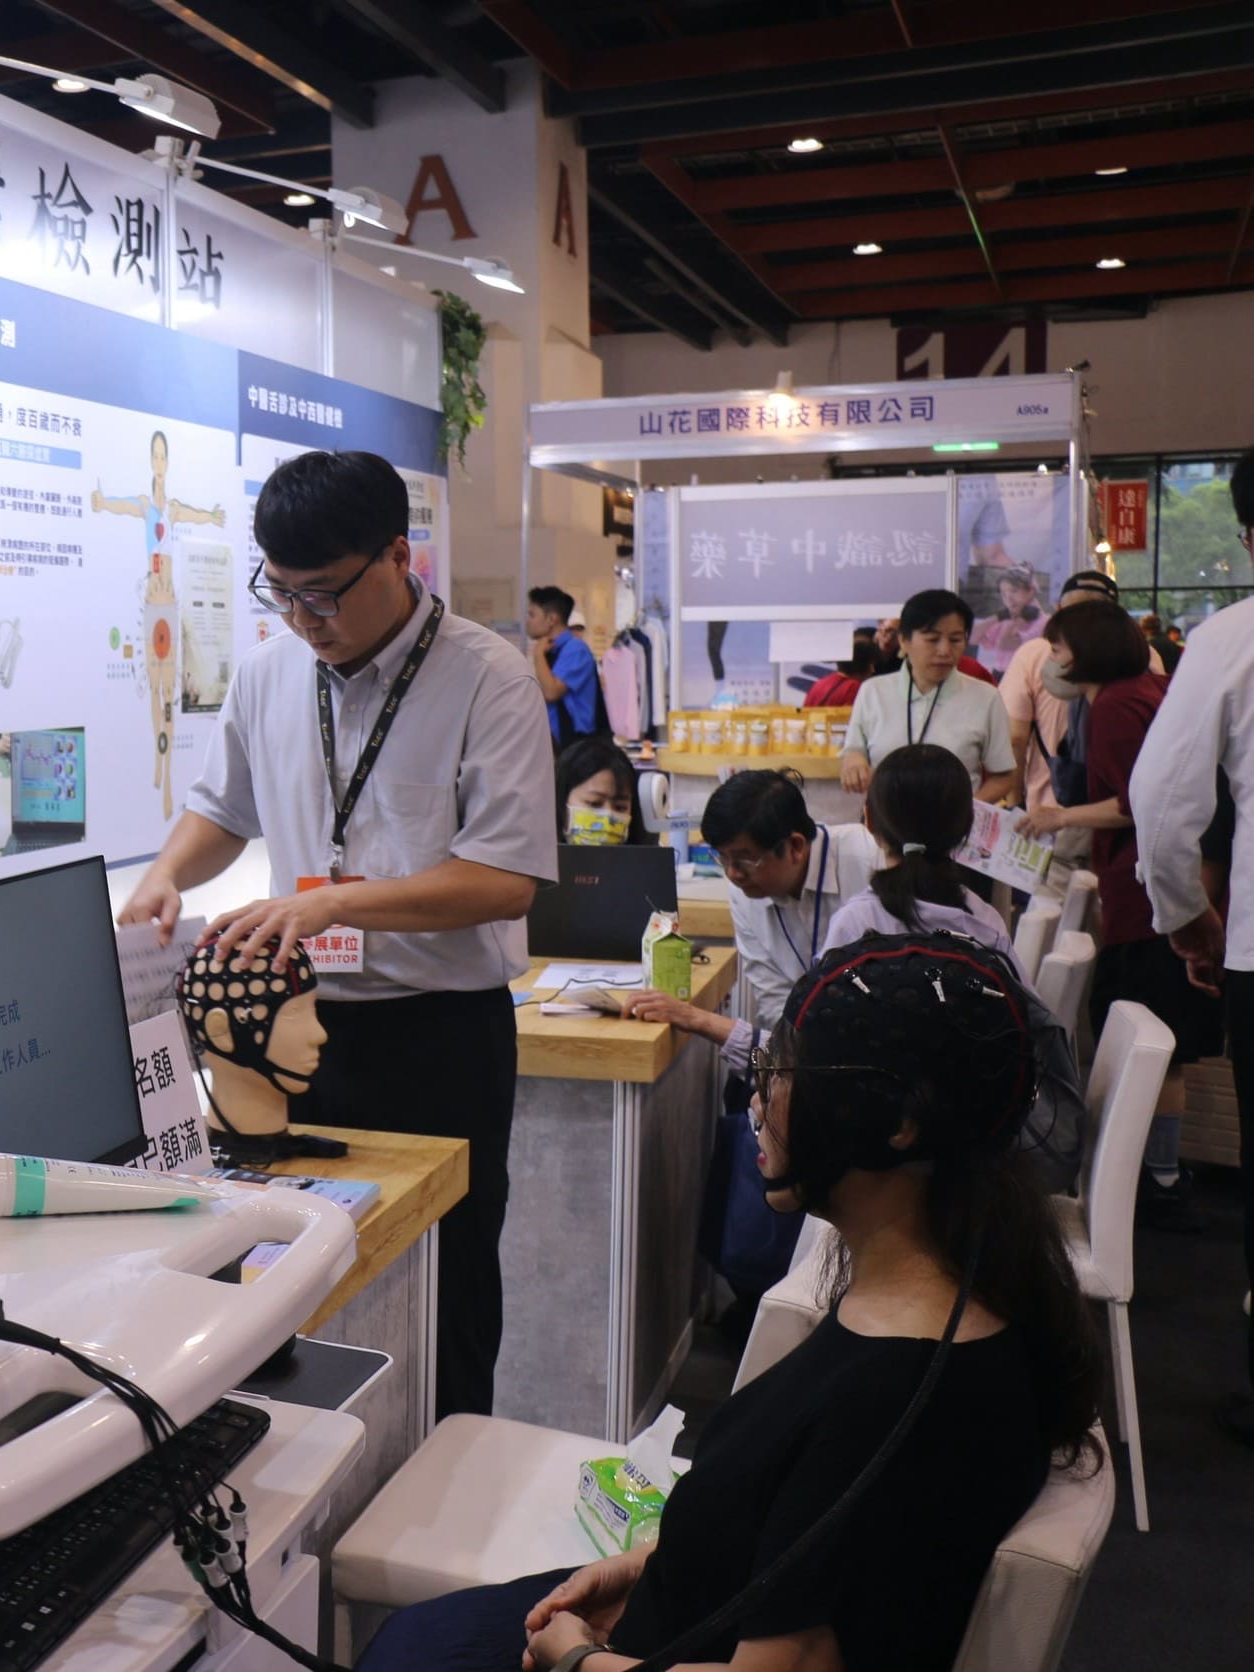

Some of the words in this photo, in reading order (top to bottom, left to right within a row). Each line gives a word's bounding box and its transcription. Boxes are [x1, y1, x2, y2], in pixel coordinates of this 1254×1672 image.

[395, 154, 478, 246] A
[552, 163, 578, 258] A
[639, 395, 934, 436] 山花國際科技有限公司
[135, 1046, 176, 1098] 名額
